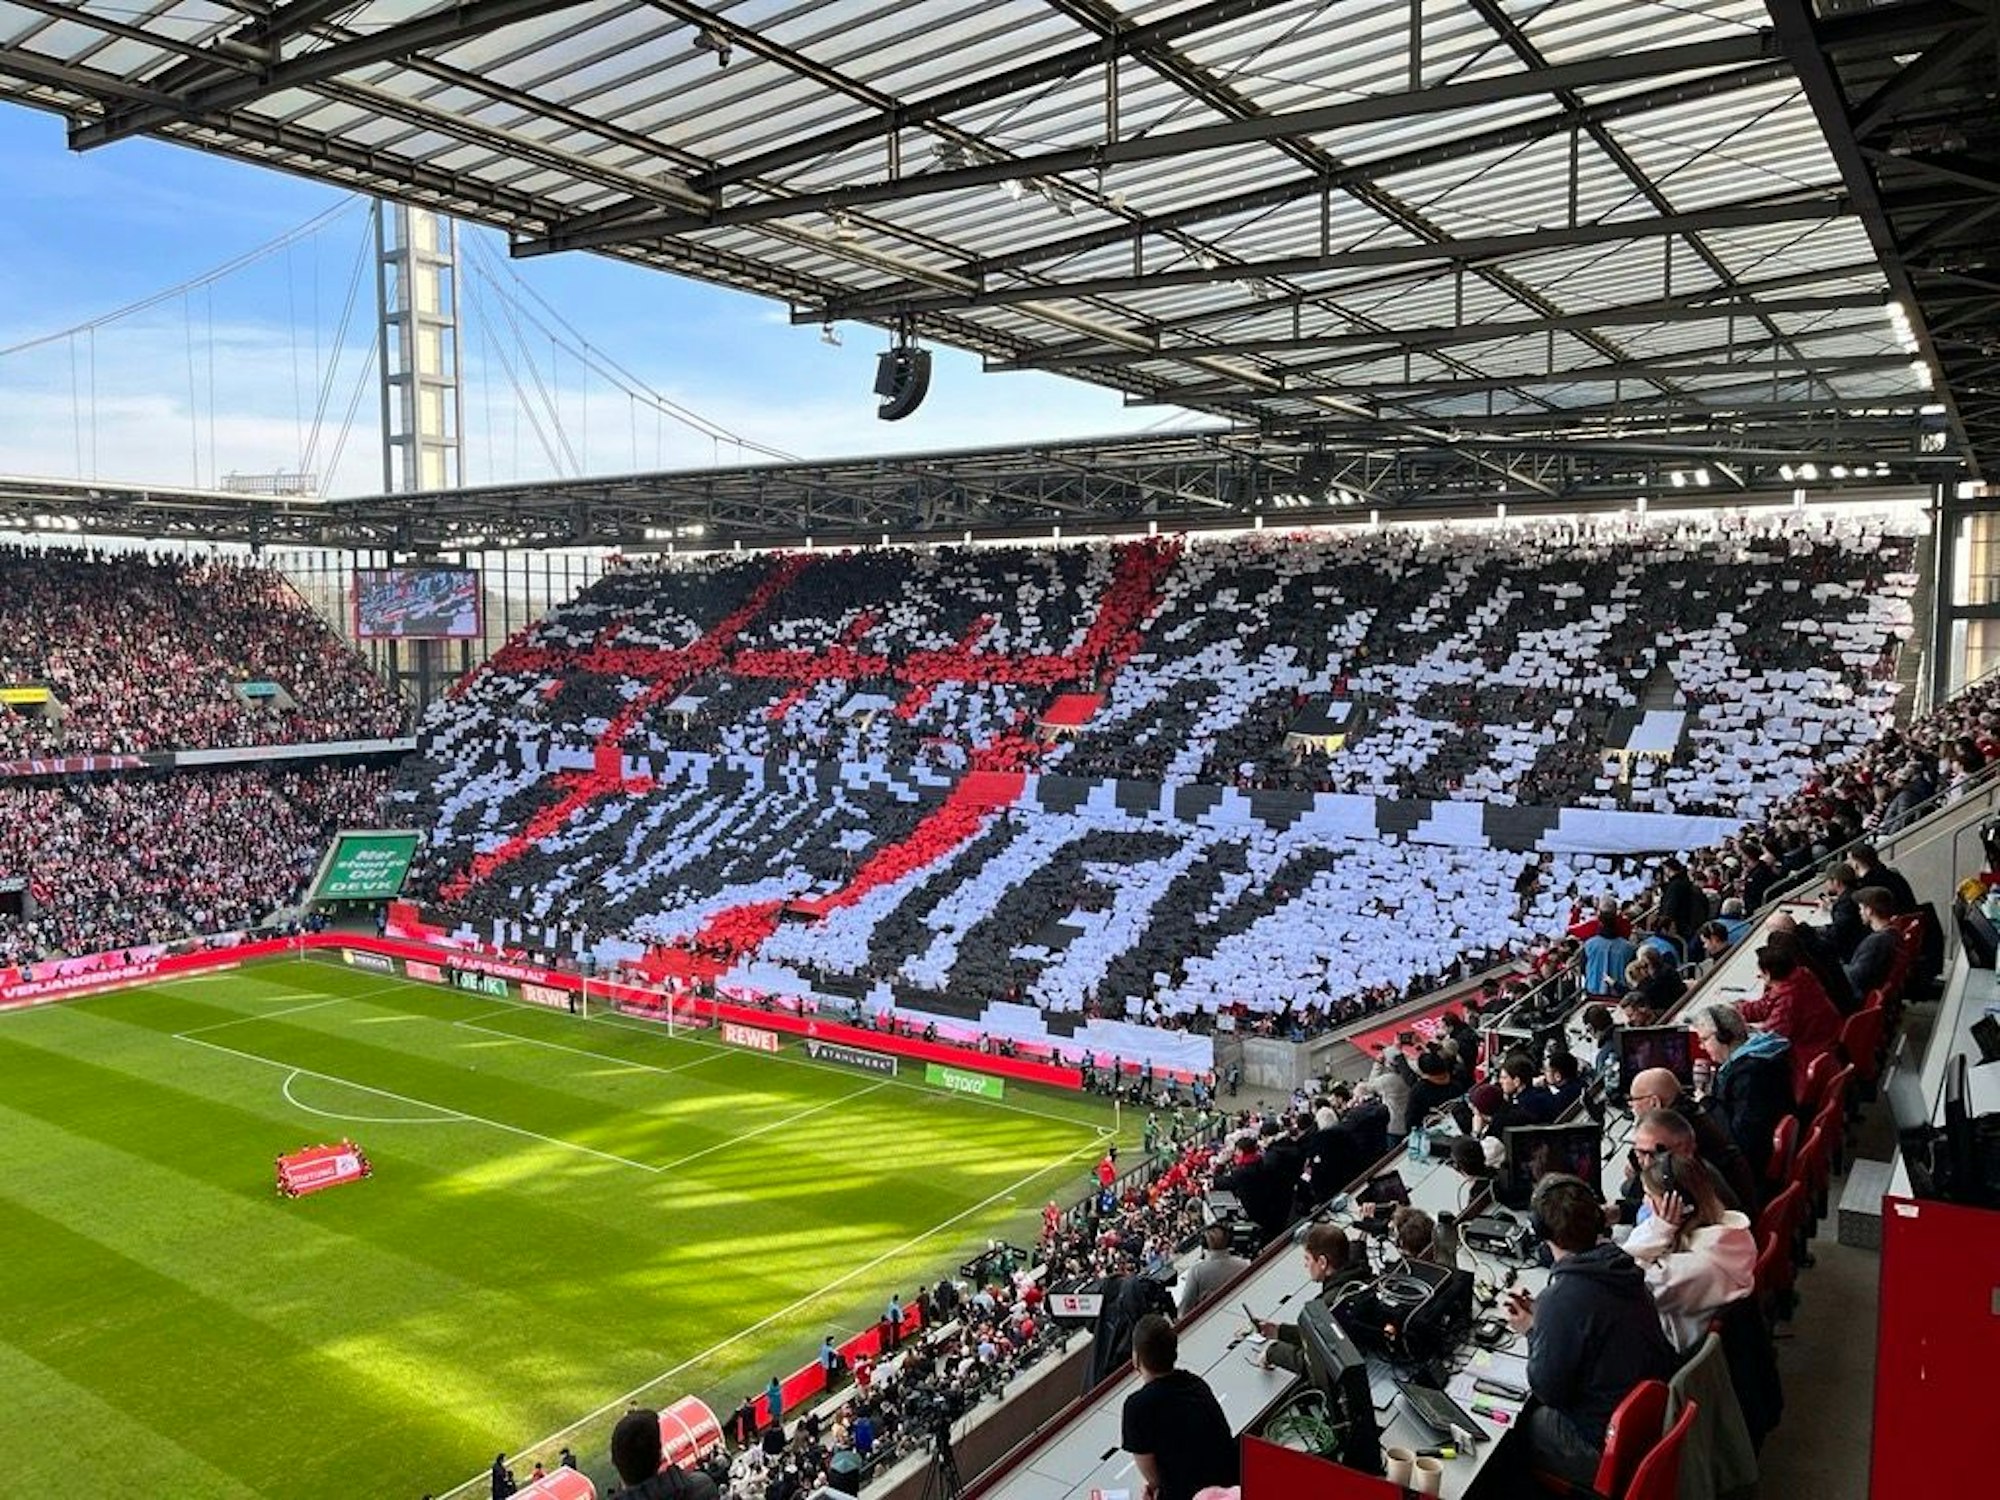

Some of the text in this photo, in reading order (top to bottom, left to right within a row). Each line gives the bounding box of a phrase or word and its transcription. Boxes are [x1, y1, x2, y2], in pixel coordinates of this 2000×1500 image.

[330, 881, 391, 892] DEVK
[527, 986, 570, 1009] REWE
[725, 1027, 770, 1048] REWE
